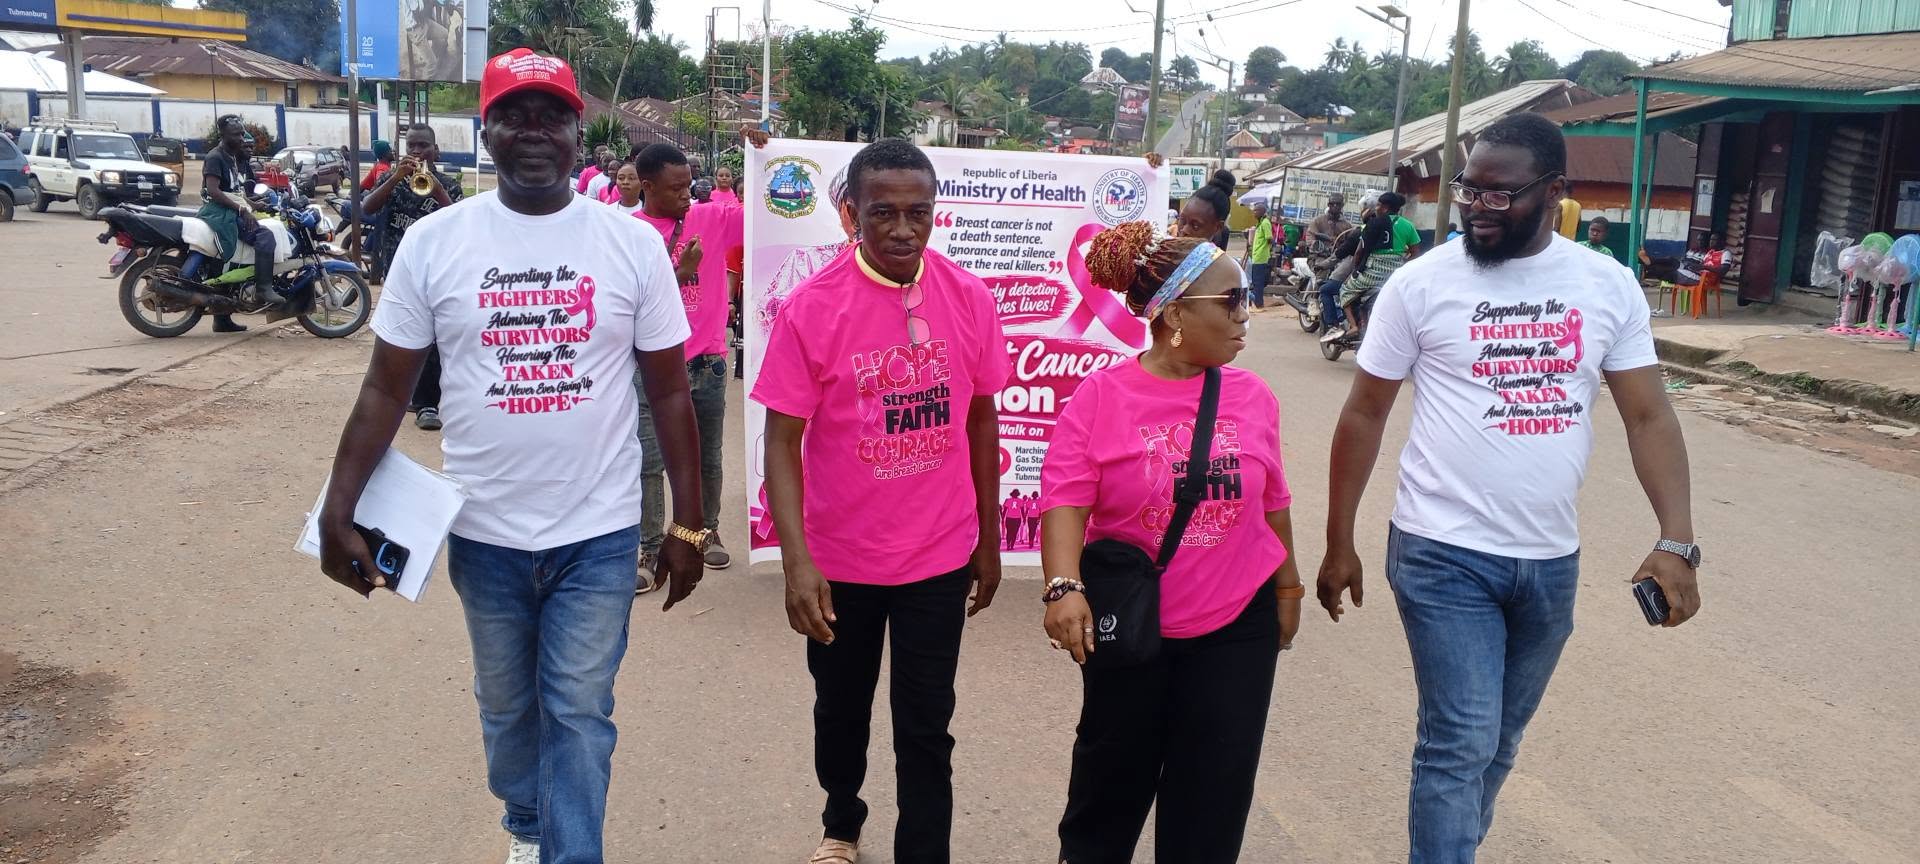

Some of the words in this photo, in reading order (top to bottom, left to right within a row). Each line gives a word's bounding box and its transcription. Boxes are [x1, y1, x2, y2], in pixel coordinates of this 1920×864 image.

[8, 8, 47, 19] Tubmanburg
[963, 168, 1006, 179] Republic
[1010, 169, 1021, 179] of
[1022, 170, 1057, 181] Liberia
[936, 180, 1006, 202] Ministry
[1010, 183, 1029, 200] of
[1032, 184, 1087, 202] Health
[990, 220, 1023, 230] cancer
[1025, 219, 1034, 230] is
[1035, 221, 1053, 231] not
[950, 232, 957, 241] a
[960, 231, 991, 243] death
[994, 233, 1043, 245] sentence.
[947, 244, 998, 257] Ignorance
[1000, 246, 1020, 257] and
[1023, 247, 1056, 258] silence
[975, 259, 992, 270] the
[994, 260, 1013, 270] real
[480, 267, 553, 290] Supporting
[556, 265, 578, 281] the
[478, 289, 579, 308] FIGHTERS
[1009, 282, 1060, 296] detection
[996, 301, 1017, 314] ves
[1020, 296, 1056, 312] lives!
[1472, 301, 1543, 324] Supporting
[1545, 299, 1566, 315] the
[487, 311, 547, 329] Admiring
[548, 308, 570, 326] The
[480, 327, 591, 346] SURVIVORS
[1469, 322, 1568, 341] FIGHTERS
[496, 347, 553, 366] Honoring
[553, 344, 577, 361] The
[1478, 343, 1537, 361] Admiring
[1538, 341, 1559, 357] The
[503, 363, 575, 381] TAKEN
[852, 340, 951, 392] HOPE
[1471, 359, 1578, 378] SURVIVORS
[485, 382, 506, 397] And
[506, 384, 536, 397] Never
[536, 383, 556, 394] Ever
[556, 380, 582, 395] Giving
[582, 376, 593, 392] Up
[1488, 375, 1543, 391] Honoring
[882, 383, 950, 406] strength
[1498, 387, 1567, 404] TAKEN
[506, 395, 572, 414] HOPE
[1483, 405, 1505, 419] And
[1506, 405, 1535, 418] Never
[1535, 407, 1552, 416] Ever
[1552, 404, 1573, 417] Giving
[1573, 402, 1583, 416] Up
[885, 401, 950, 435] FAITH
[1507, 417, 1565, 435] HOPE
[1028, 428, 1044, 436] on
[1139, 420, 1241, 460] HOE
[857, 427, 952, 465] COURAGE
[874, 466, 893, 480] Cure
[893, 463, 918, 478] Breast
[918, 459, 942, 474] Cancer
